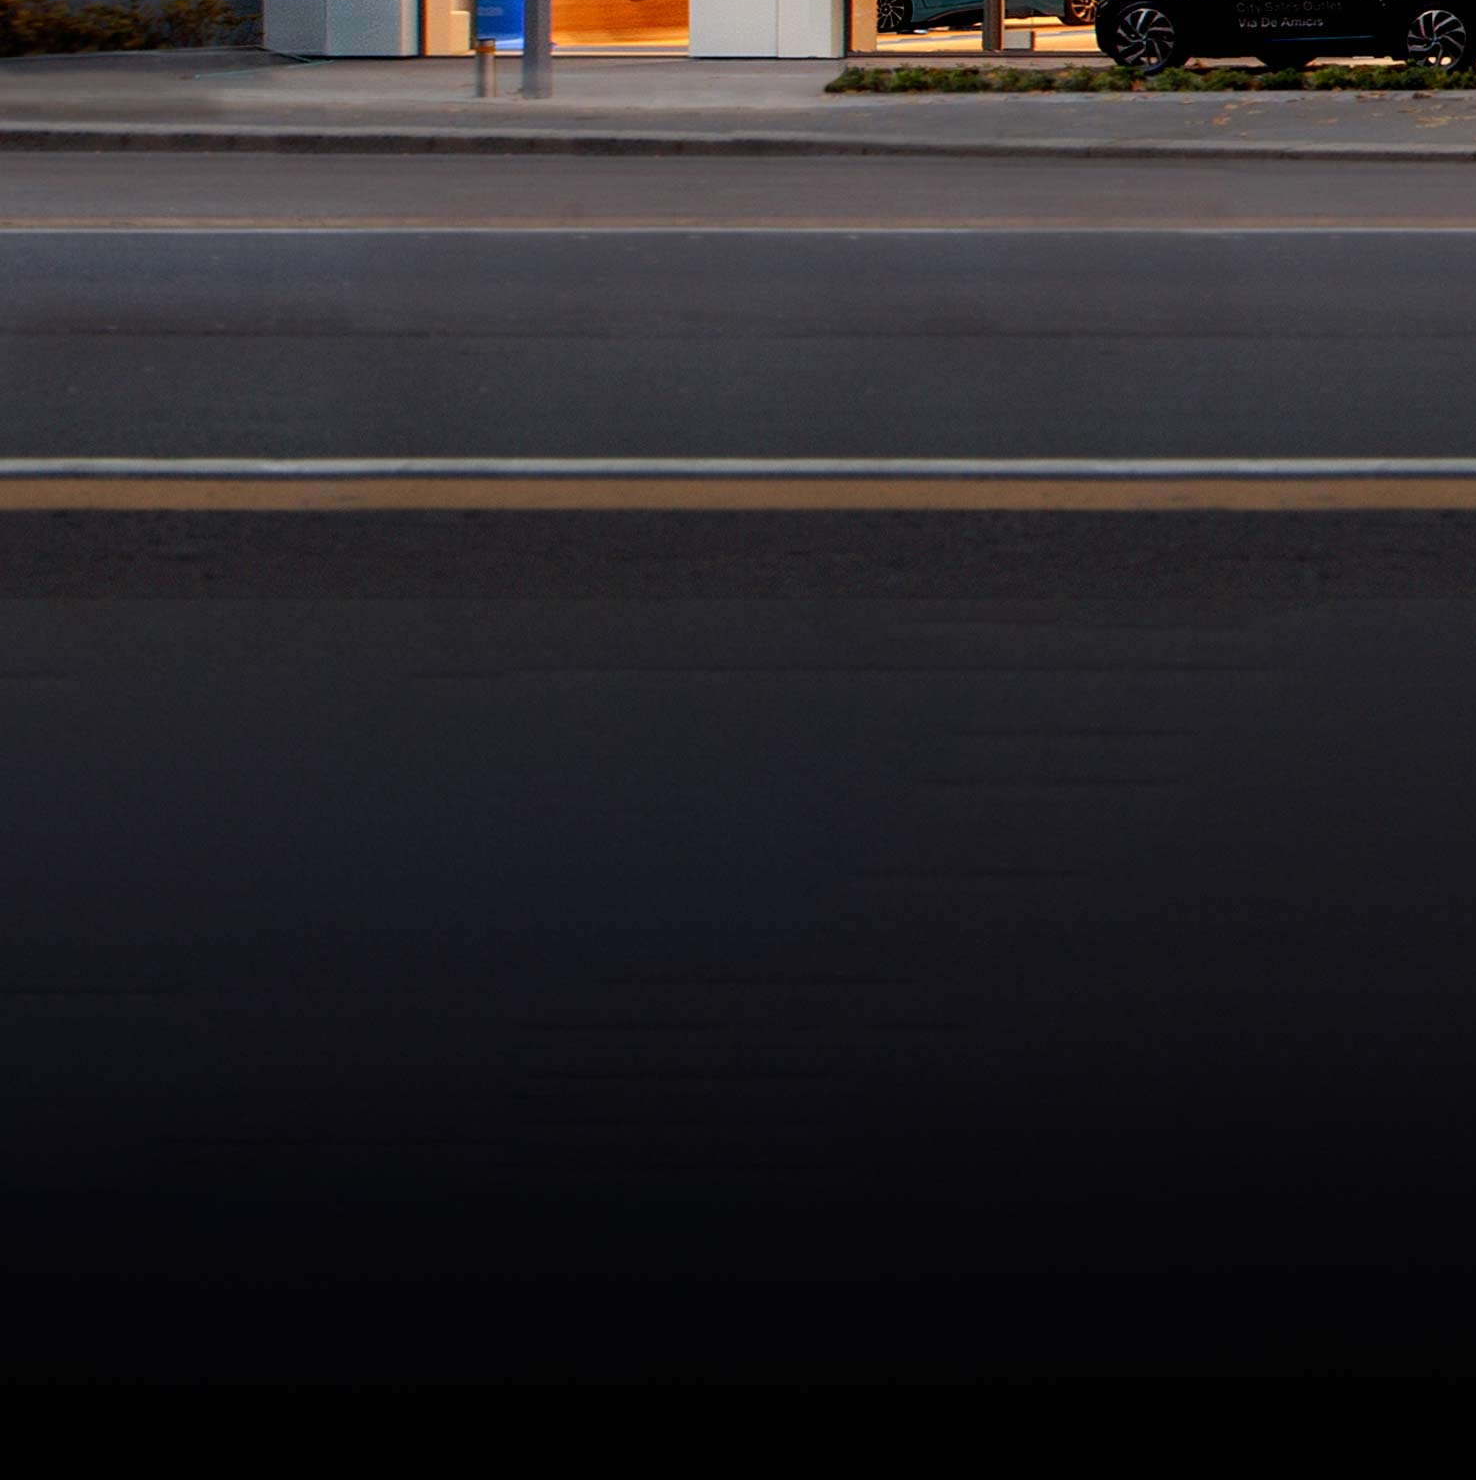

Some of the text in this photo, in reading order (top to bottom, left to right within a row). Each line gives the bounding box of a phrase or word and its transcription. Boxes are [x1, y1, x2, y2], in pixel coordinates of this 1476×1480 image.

[1238, 17, 1324, 28] Via De Amicis
